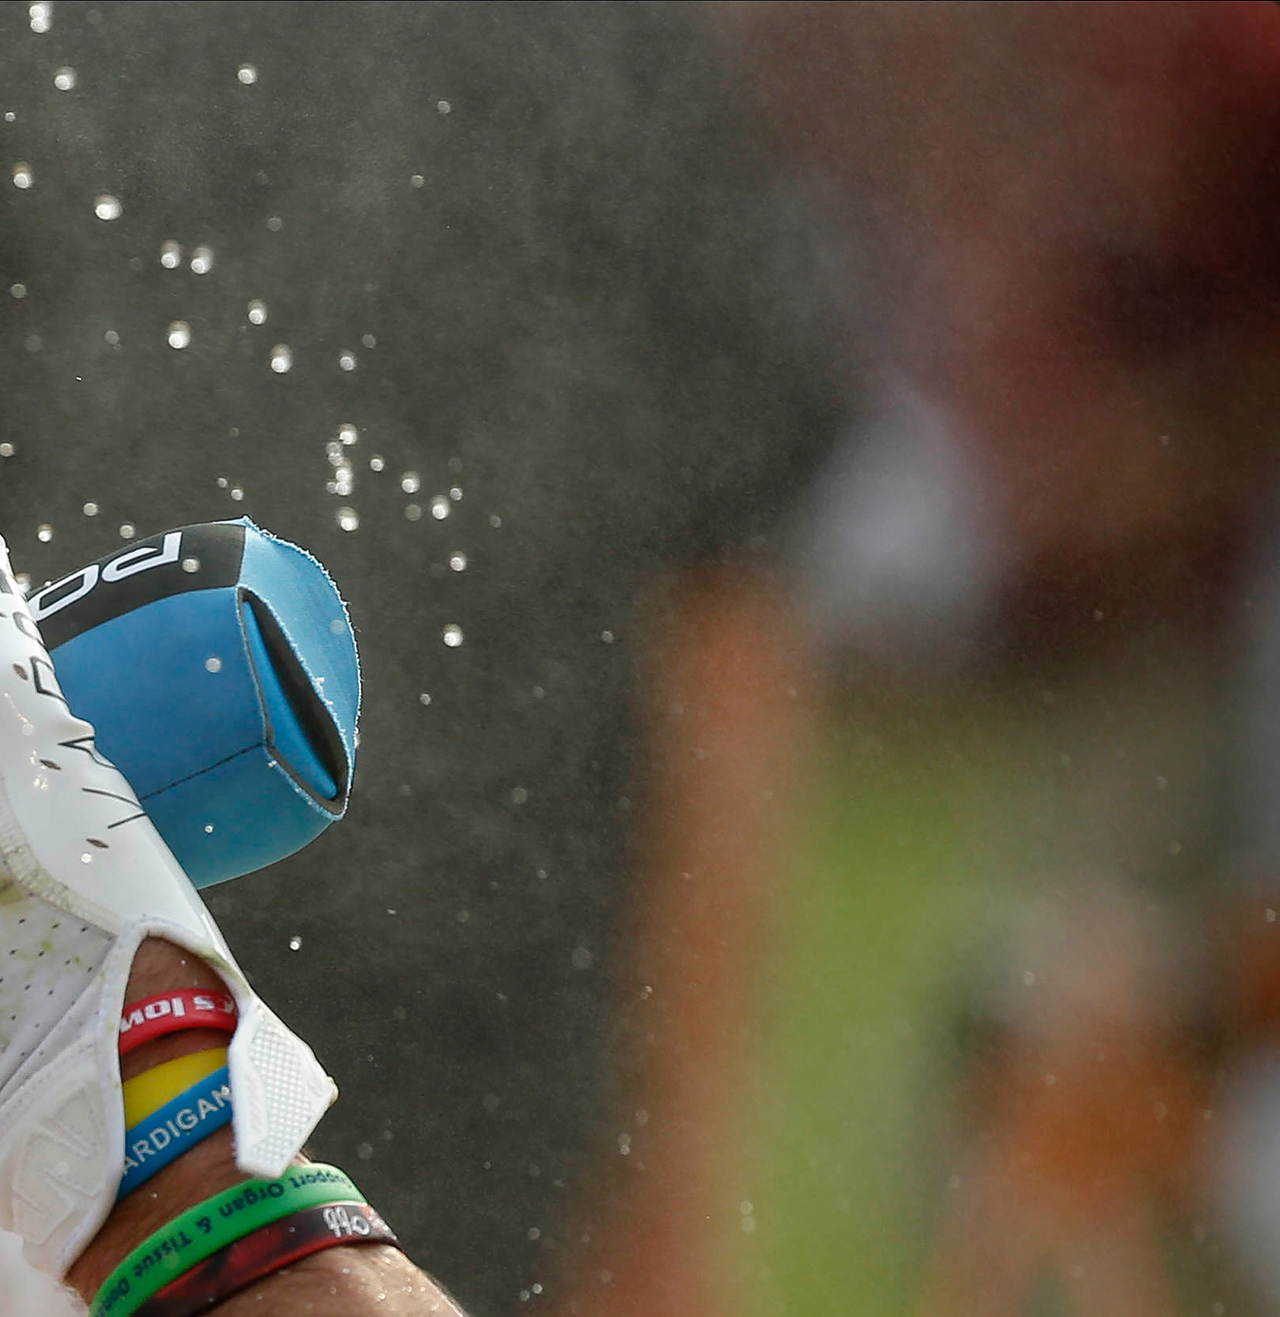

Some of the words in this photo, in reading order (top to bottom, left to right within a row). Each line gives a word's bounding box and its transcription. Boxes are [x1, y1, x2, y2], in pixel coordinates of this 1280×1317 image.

[120, 1085, 231, 1176] ARDIGAN
[219, 1181, 284, 1218] Organ
[196, 1216, 213, 1233] &
[134, 1231, 193, 1278] Tissue
